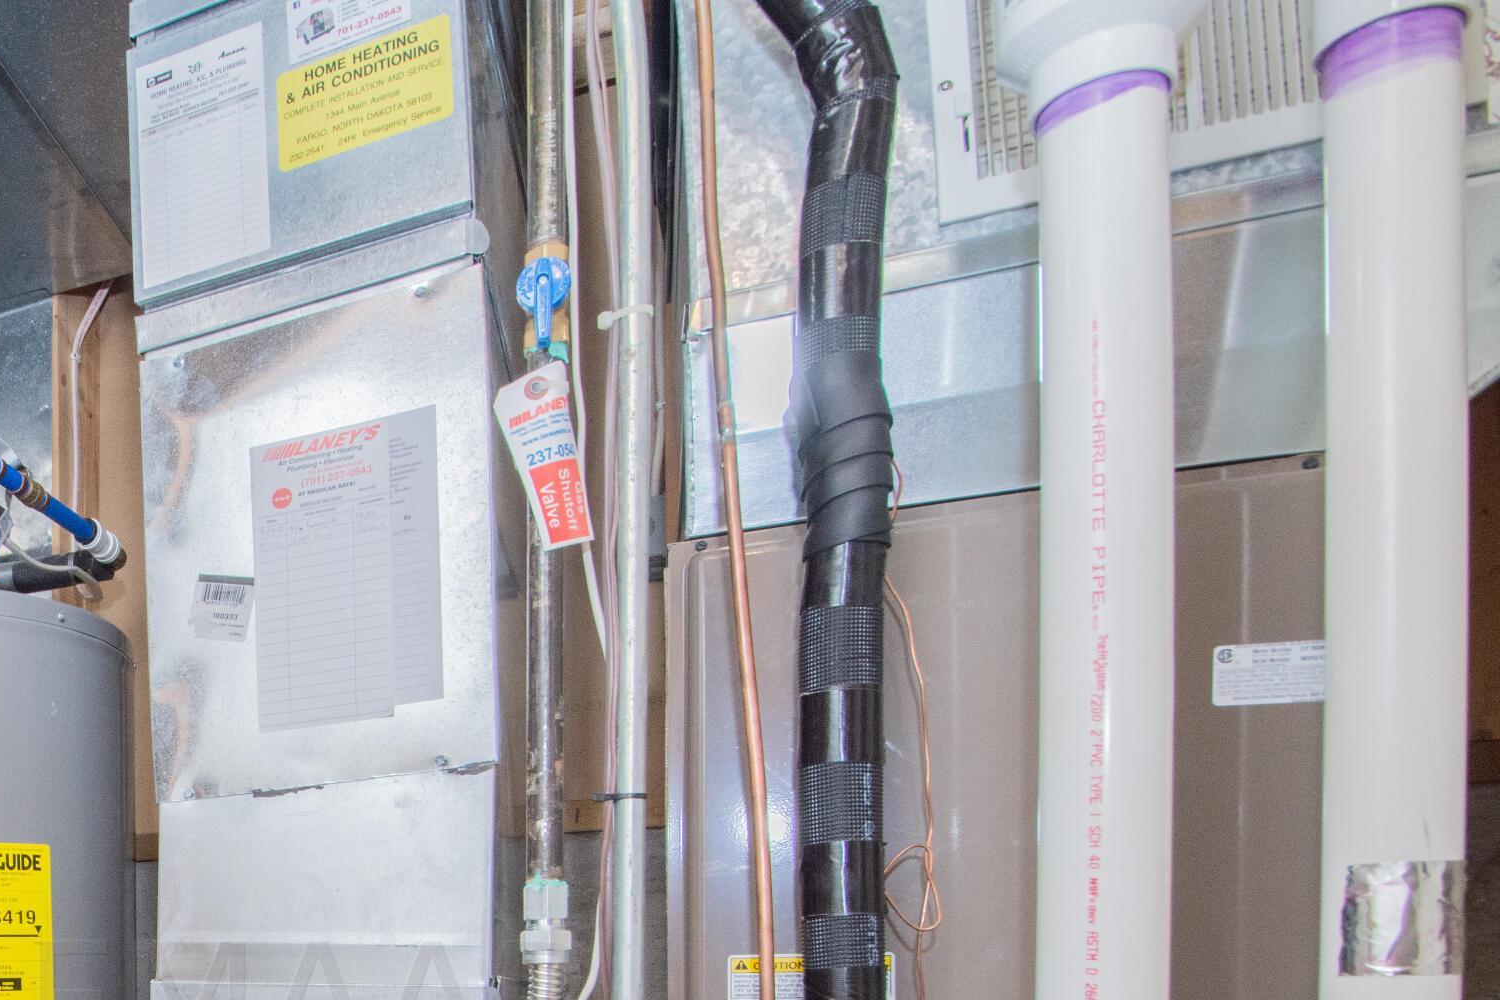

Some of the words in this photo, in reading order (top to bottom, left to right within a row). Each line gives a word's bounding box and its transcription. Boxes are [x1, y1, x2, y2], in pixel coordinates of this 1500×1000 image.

[336, 5, 402, 36] 701-237-0543
[286, 93, 295, 104] &
[301, 81, 326, 99] AIR
[332, 40, 440, 88] CONDITIONING
[304, 58, 346, 82] HOME
[353, 32, 419, 64] HEATING
[284, 100, 325, 120] COMPLETE
[329, 80, 384, 105] INSTALLATION
[388, 73, 404, 83] AND
[408, 57, 443, 77] SERVICE
[326, 108, 344, 120] 1344
[348, 101, 368, 113] Main
[371, 89, 401, 104] Avenue
[332, 115, 364, 132] NORTH
[367, 103, 404, 121] DAKOTA
[407, 92, 432, 107] 58103
[289, 145, 325, 162] 232-2541
[362, 119, 408, 138] Emergency
[411, 106, 443, 121] Service
[293, 423, 381, 456] LANEY'S
[278, 459, 287, 467] Air
[289, 450, 332, 466] Conditioning
[337, 444, 363, 456] Heating
[287, 460, 318, 473] Plumbing
[323, 454, 356, 466] Electrical
[1091, 399, 1106, 532] CHARLOTTE
[301, 475, 325, 489] (701)
[328, 465, 373, 483] 237-0543
[539, 482, 561, 530] Valve
[558, 468, 578, 532] Shutoff
[574, 482, 585, 514] Gas
[1091, 545, 1106, 604] PIPE
[1090, 693, 1103, 722] 7200
[1088, 775, 1103, 804] TYPE
[1088, 826, 1102, 850] SCH
[1088, 854, 1101, 870] 40
[1086, 931, 1100, 962] ASTM
[753, 959, 805, 970] CUTION
